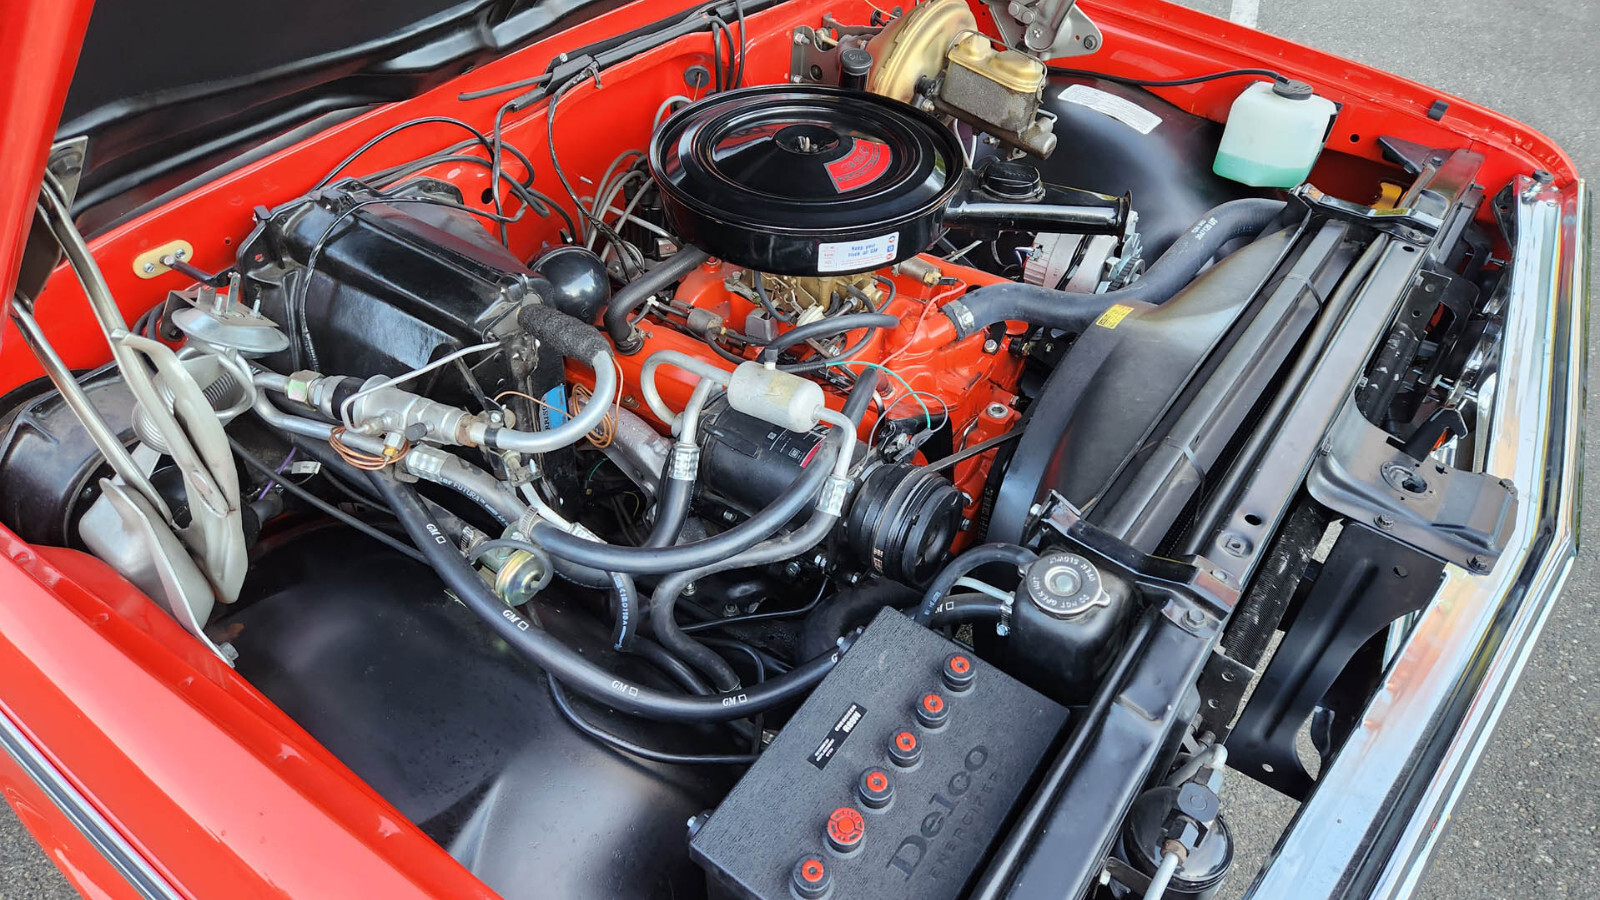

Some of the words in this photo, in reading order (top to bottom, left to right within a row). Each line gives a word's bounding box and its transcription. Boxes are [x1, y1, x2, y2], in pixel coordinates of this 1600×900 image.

[848, 53, 863, 61] OIL
[426, 523, 441, 536] GM
[1049, 556, 1079, 565] SLOWLY
[1060, 600, 1078, 608] NOT
[502, 609, 521, 623] GM
[612, 680, 629, 692] GM
[722, 696, 736, 707] GM
[886, 745, 988, 882] Delco
[929, 772, 1000, 880] ENERGIZER
